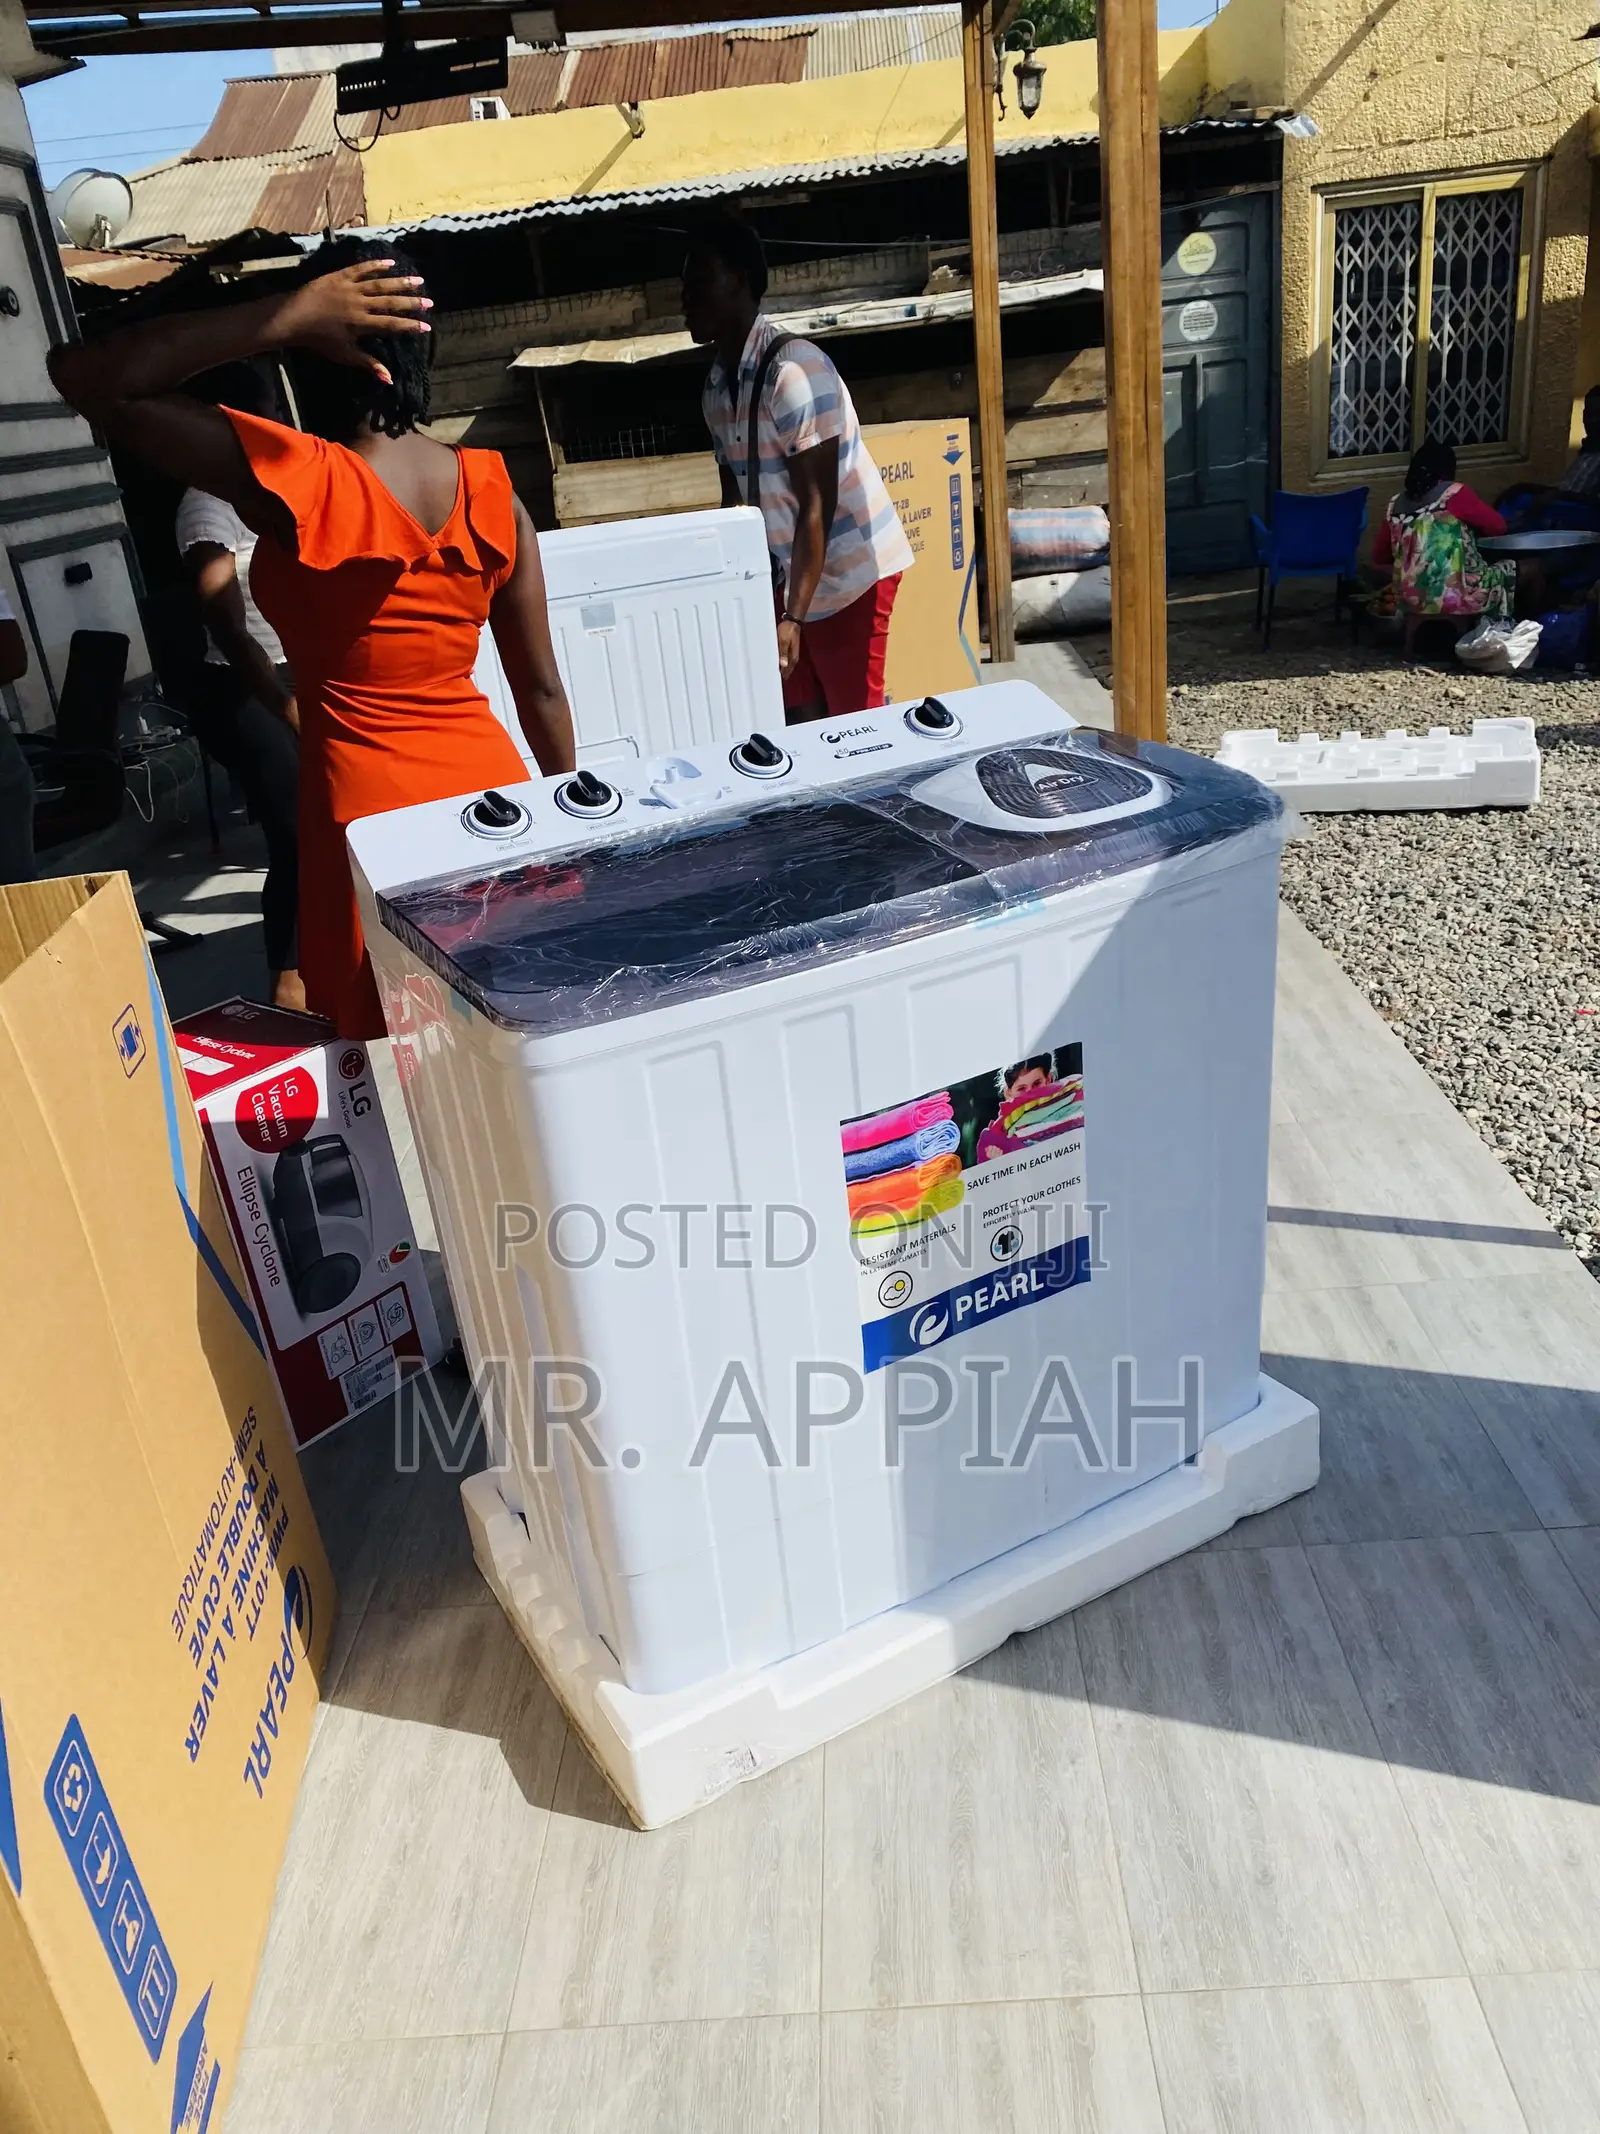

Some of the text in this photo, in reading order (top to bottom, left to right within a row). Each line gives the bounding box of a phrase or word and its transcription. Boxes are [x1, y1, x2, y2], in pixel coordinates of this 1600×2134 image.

[881, 461, 915, 484] PEARL
[904, 527, 921, 540] UVE
[909, 507, 932, 524] LAVER
[838, 725, 878, 739] PEARL
[1037, 774, 1086, 792] Air Dry
[191, 1035, 222, 1050] Ellipse
[267, 1083, 289, 1139] Vacuum
[283, 1076, 299, 1098] LG
[347, 1080, 372, 1119] LG
[250, 1092, 273, 1143] Cleaner
[342, 1108, 353, 1130] Good
[966, 1141, 1082, 1191] SAVE TIME IN EACH WASH
[982, 1175, 1082, 1220] PROTECT YOUR CLOTHES
[237, 1165, 281, 1288] Ellipse Cyclone
[860, 1223, 958, 1267] RESISTANT MATERIALS
[955, 1268, 1045, 1322] PEARL
[171, 1405, 258, 1644] SEMI-AUTOMATIQUE
[216, 1463, 260, 1583] DOUBLE
[245, 1502, 290, 1643] PWM-10TT
[184, 1471, 280, 1765] MACHINE À LAVER
[188, 1573, 222, 1671] CUVE
[242, 1629, 296, 1801] PEARL
[193, 2069, 210, 2127] FACE
